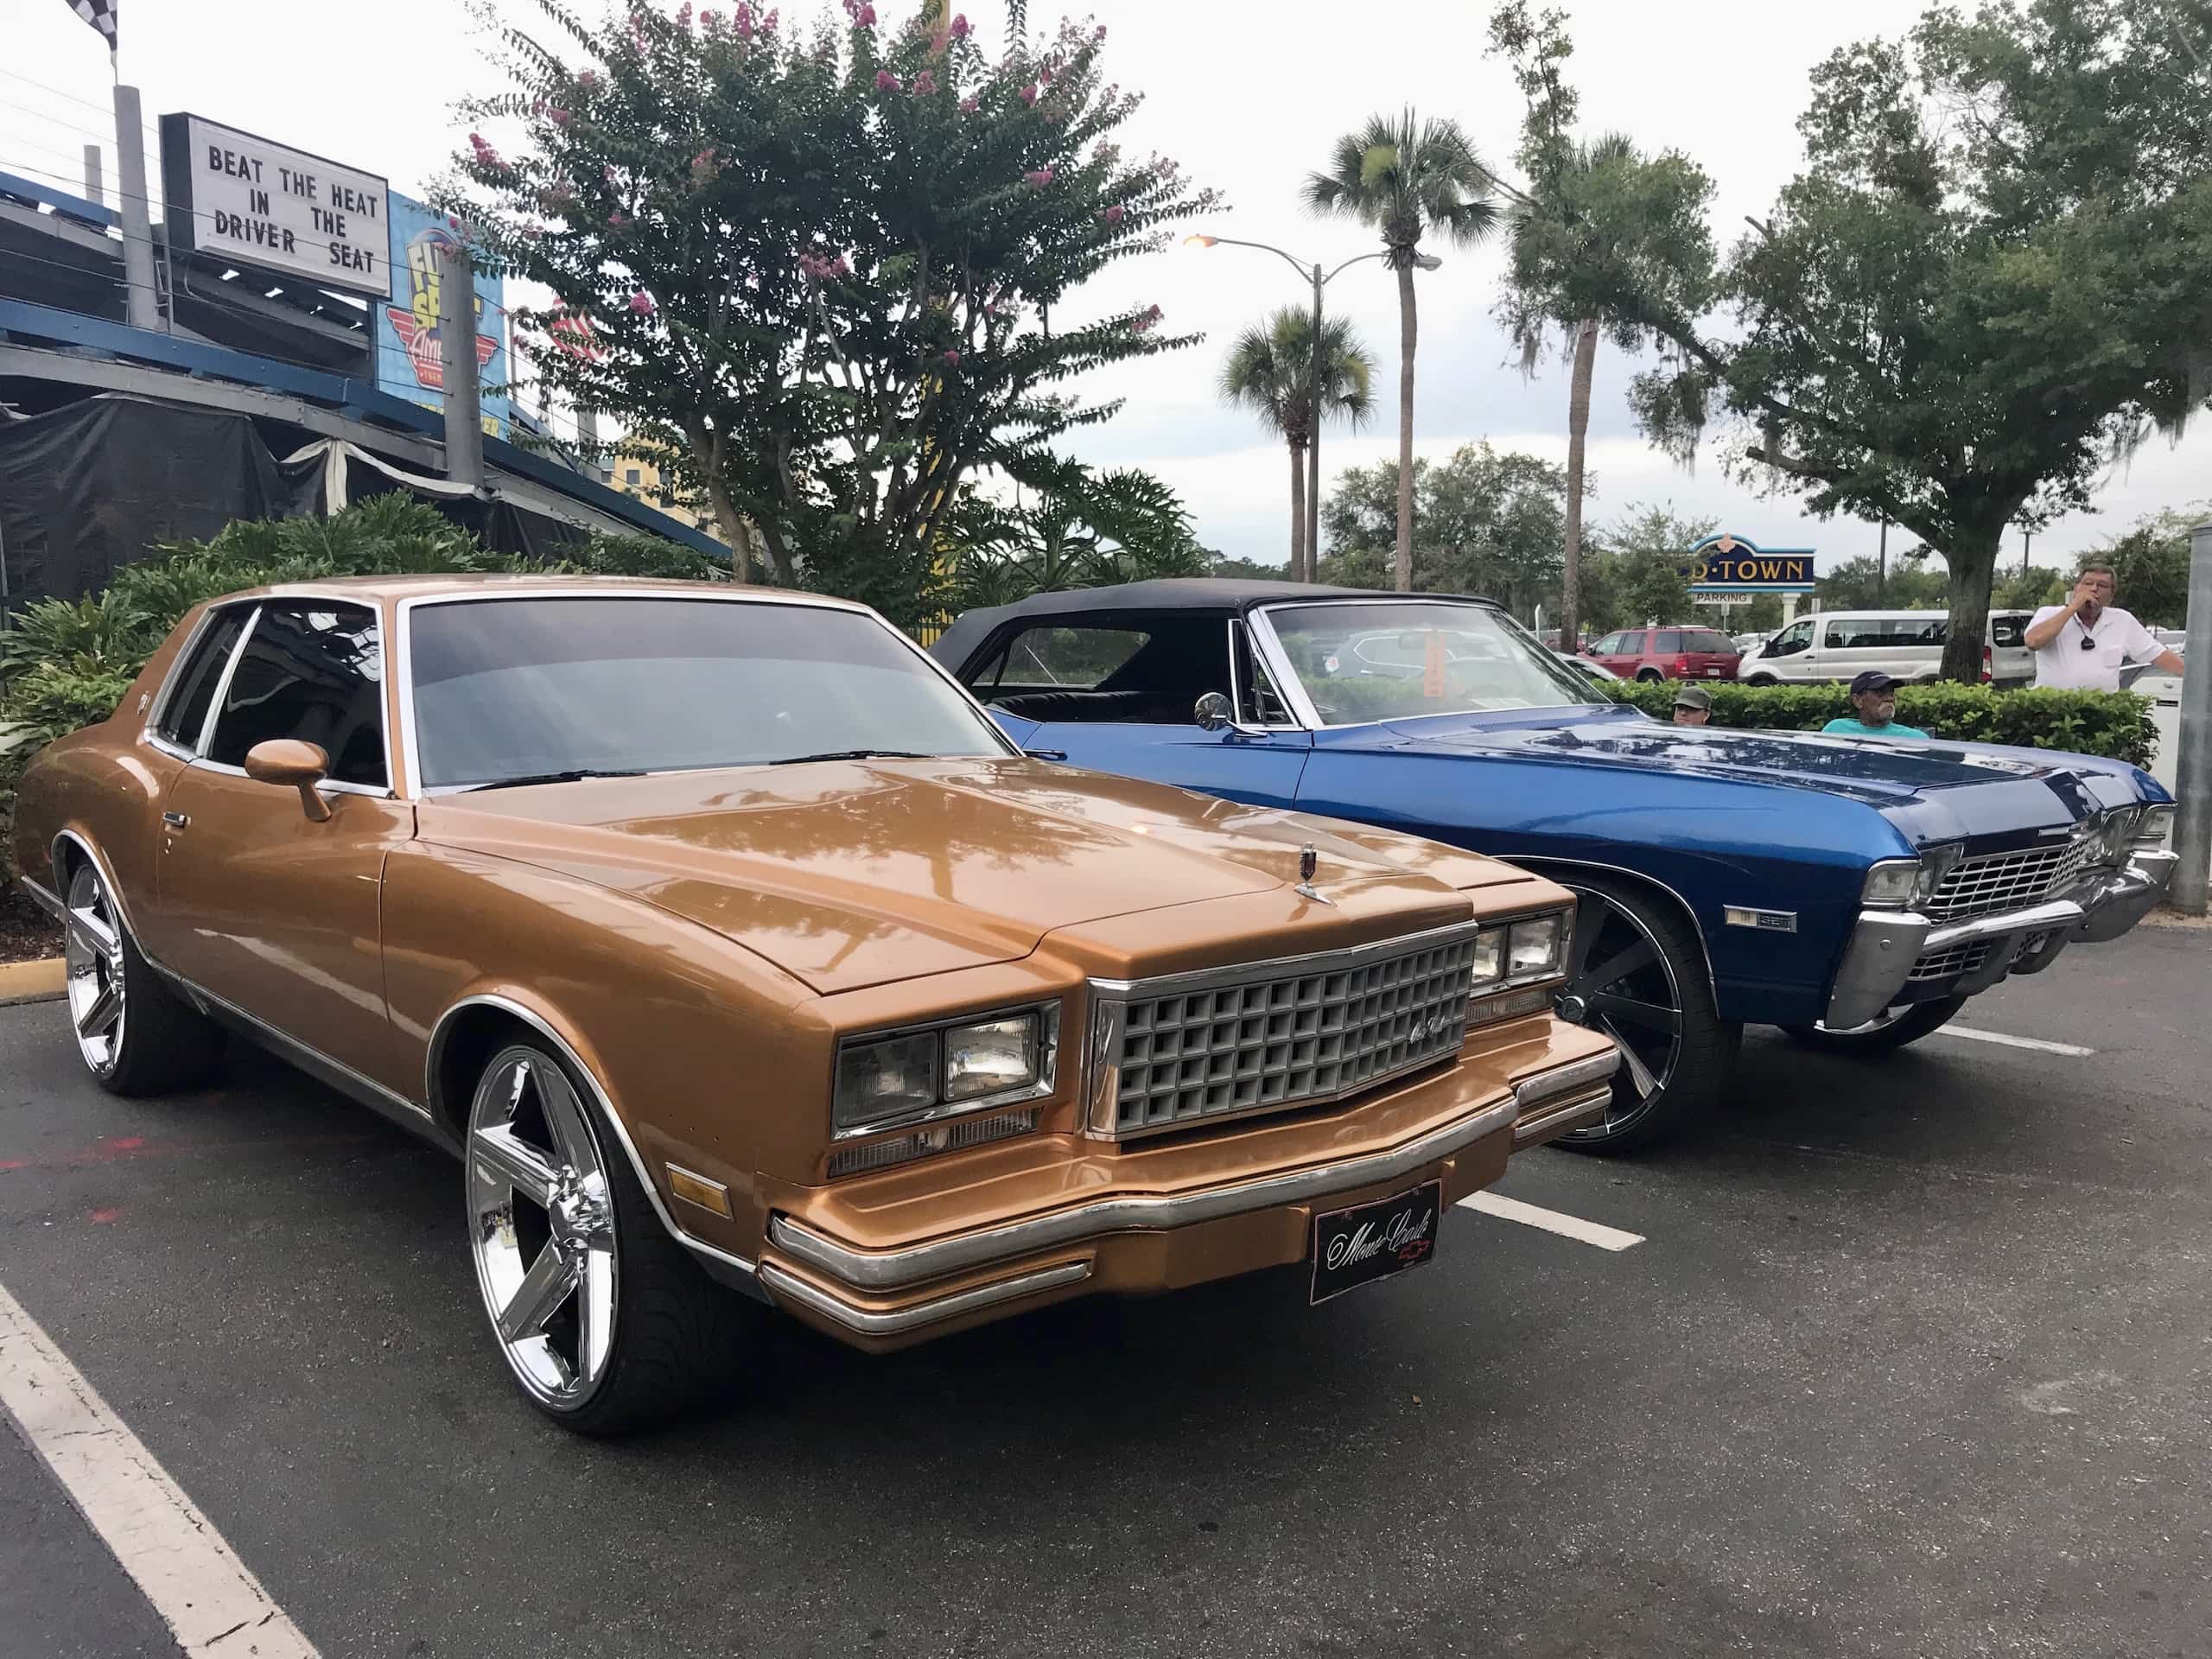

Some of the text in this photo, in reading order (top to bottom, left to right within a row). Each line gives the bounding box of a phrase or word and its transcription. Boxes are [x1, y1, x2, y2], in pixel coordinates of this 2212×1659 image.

[209, 145, 377, 219] BEAT THE HEAT
[250, 188, 346, 238] IN THE
[215, 210, 374, 273] DRIVER SEAT
[407, 241, 440, 292] FU
[1696, 593, 1747, 602] PARKING
[1327, 1208, 1432, 1270] Monte Carlo
